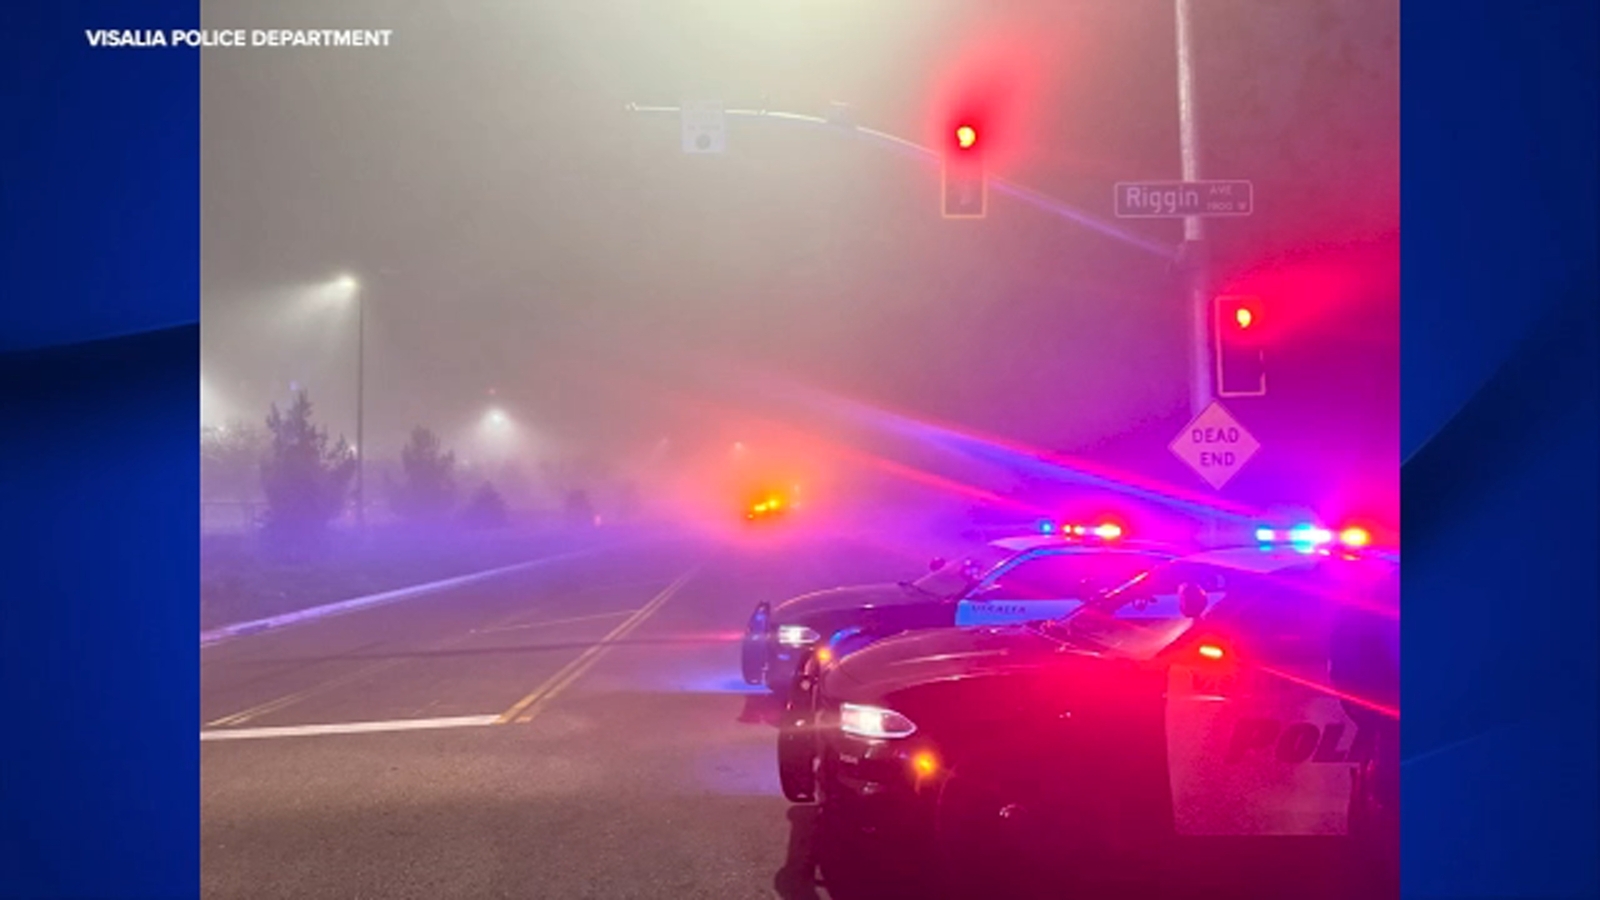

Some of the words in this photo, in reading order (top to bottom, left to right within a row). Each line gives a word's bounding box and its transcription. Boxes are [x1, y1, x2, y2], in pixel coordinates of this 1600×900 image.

[1126, 186, 1199, 213] Riggin
[1209, 185, 1233, 195] AVE
[1192, 427, 1239, 443] DEAD
[1200, 452, 1235, 466] END
